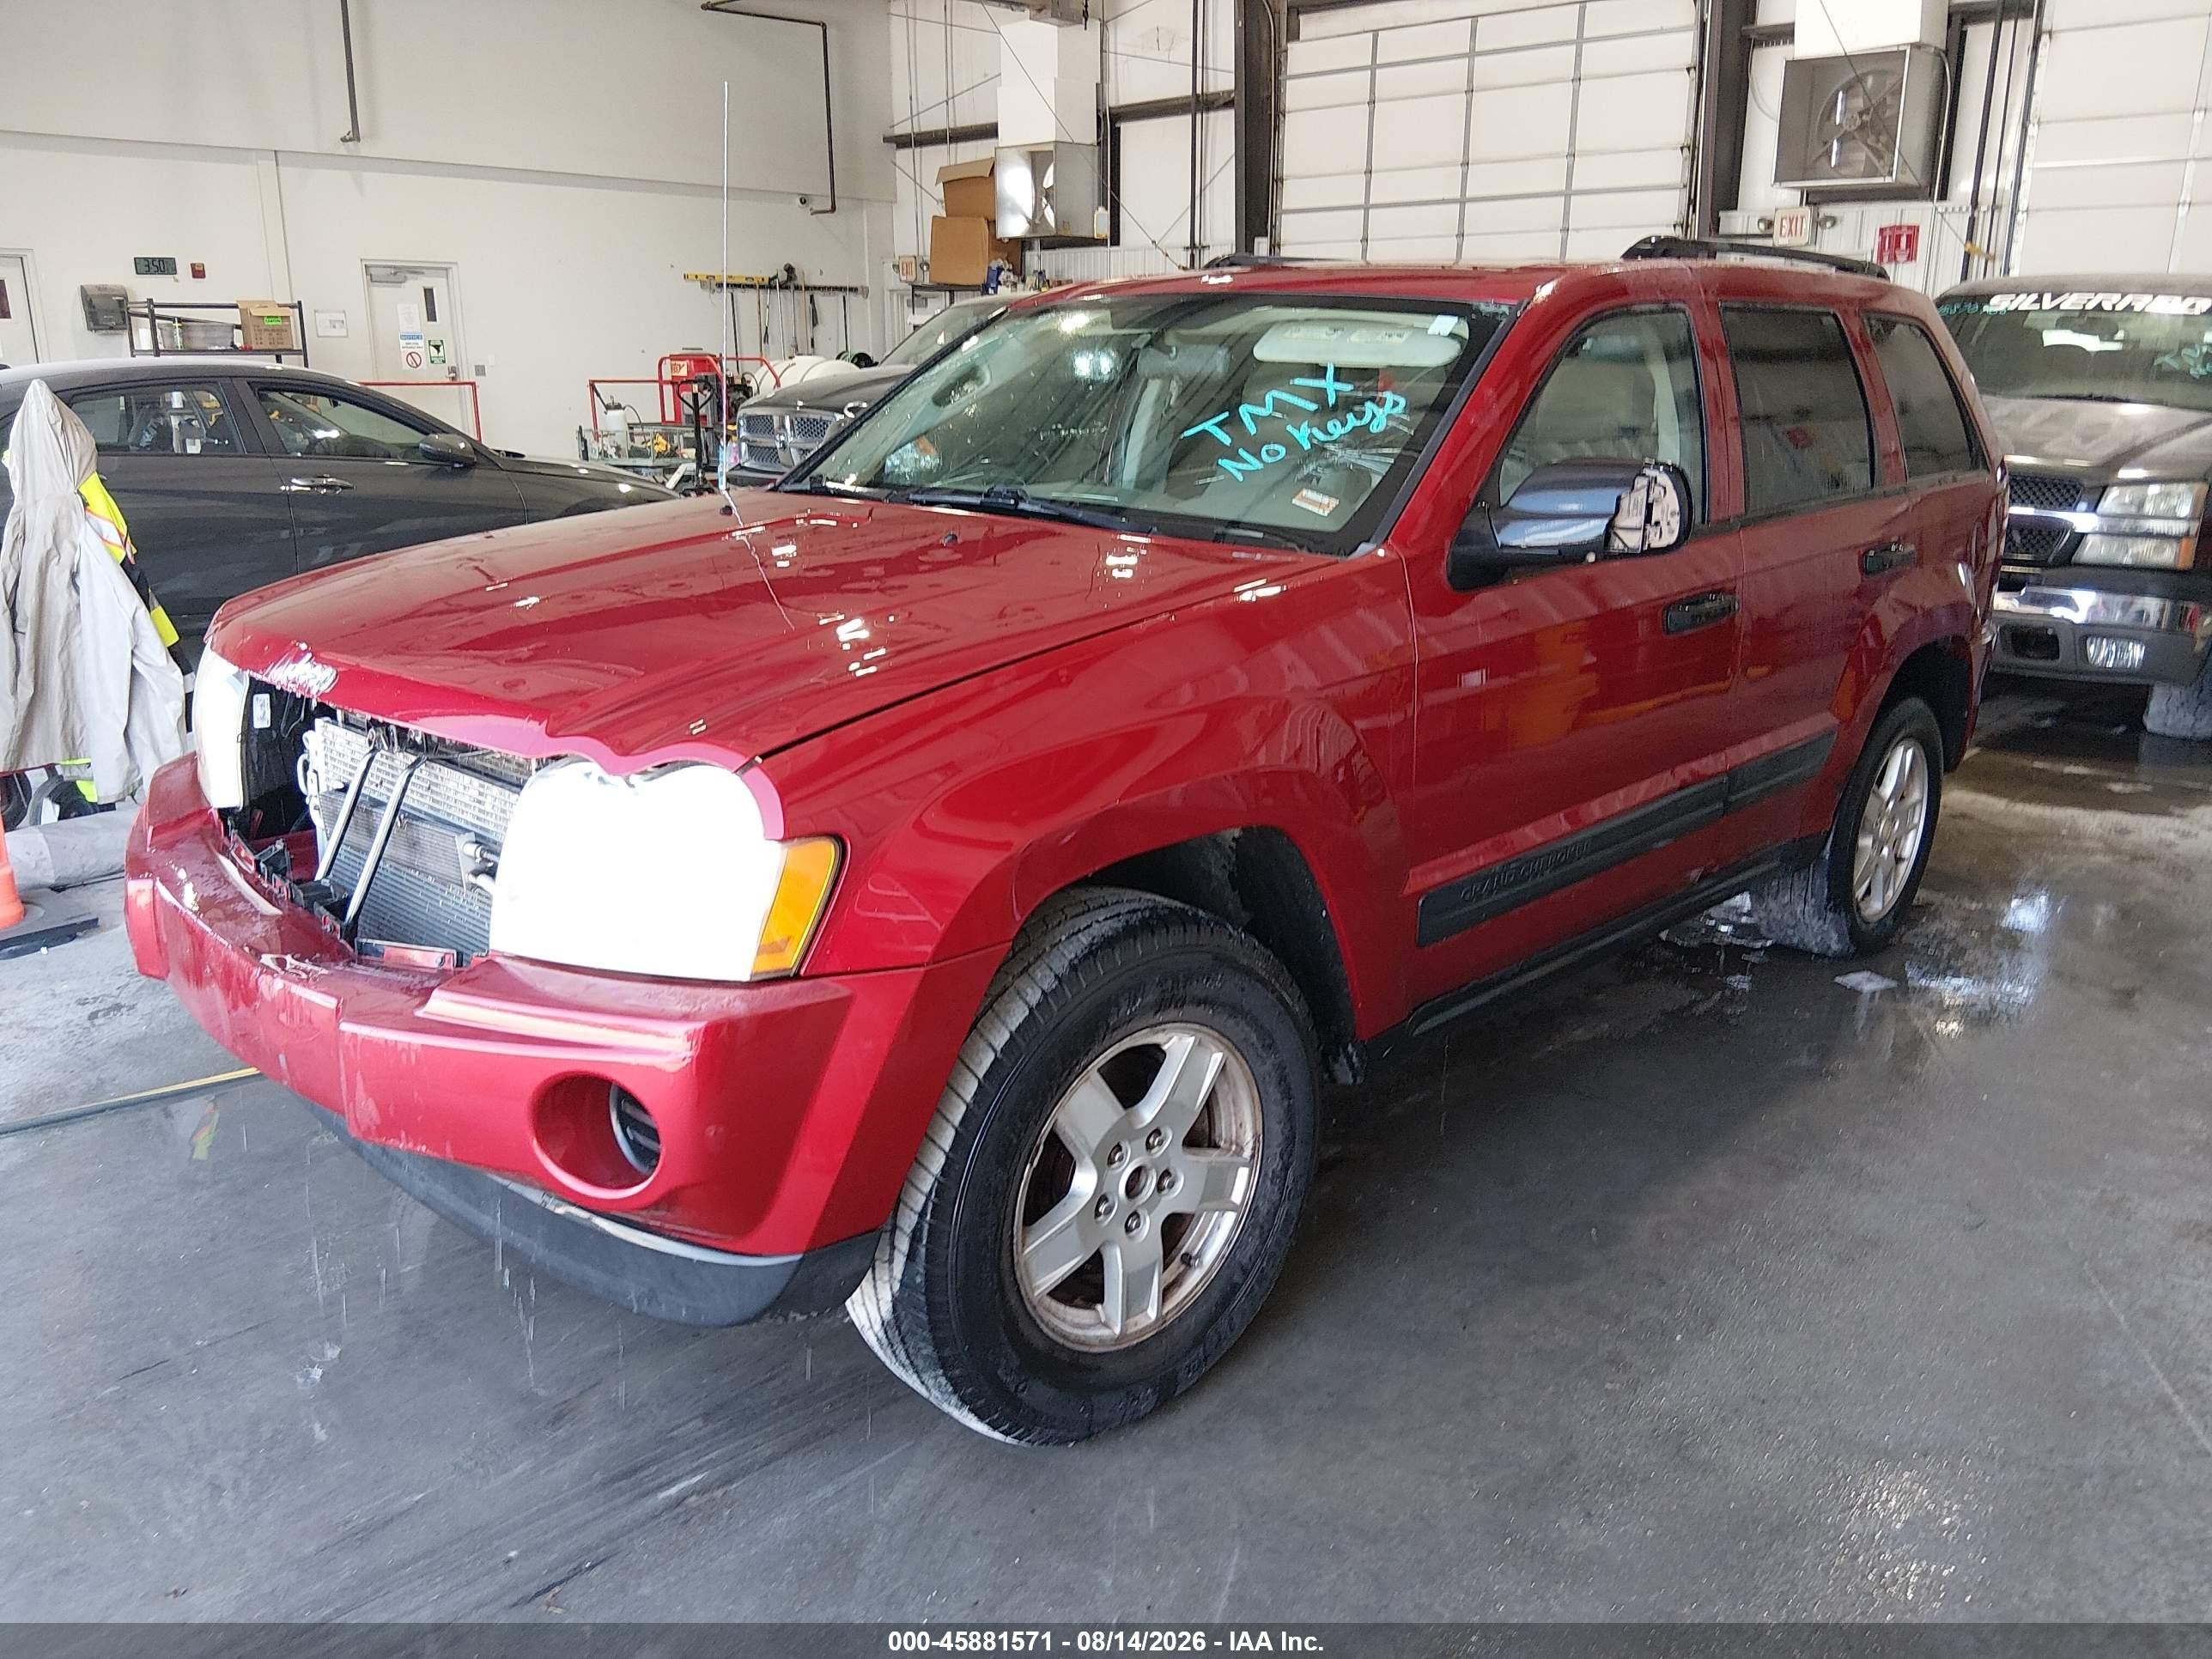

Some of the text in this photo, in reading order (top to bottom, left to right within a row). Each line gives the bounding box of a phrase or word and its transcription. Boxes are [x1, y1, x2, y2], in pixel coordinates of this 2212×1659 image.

[1779, 215, 1807, 238] EXIT
[902, 261, 913, 276] EXIT
[1990, 292, 2212, 316] SILVERADO
